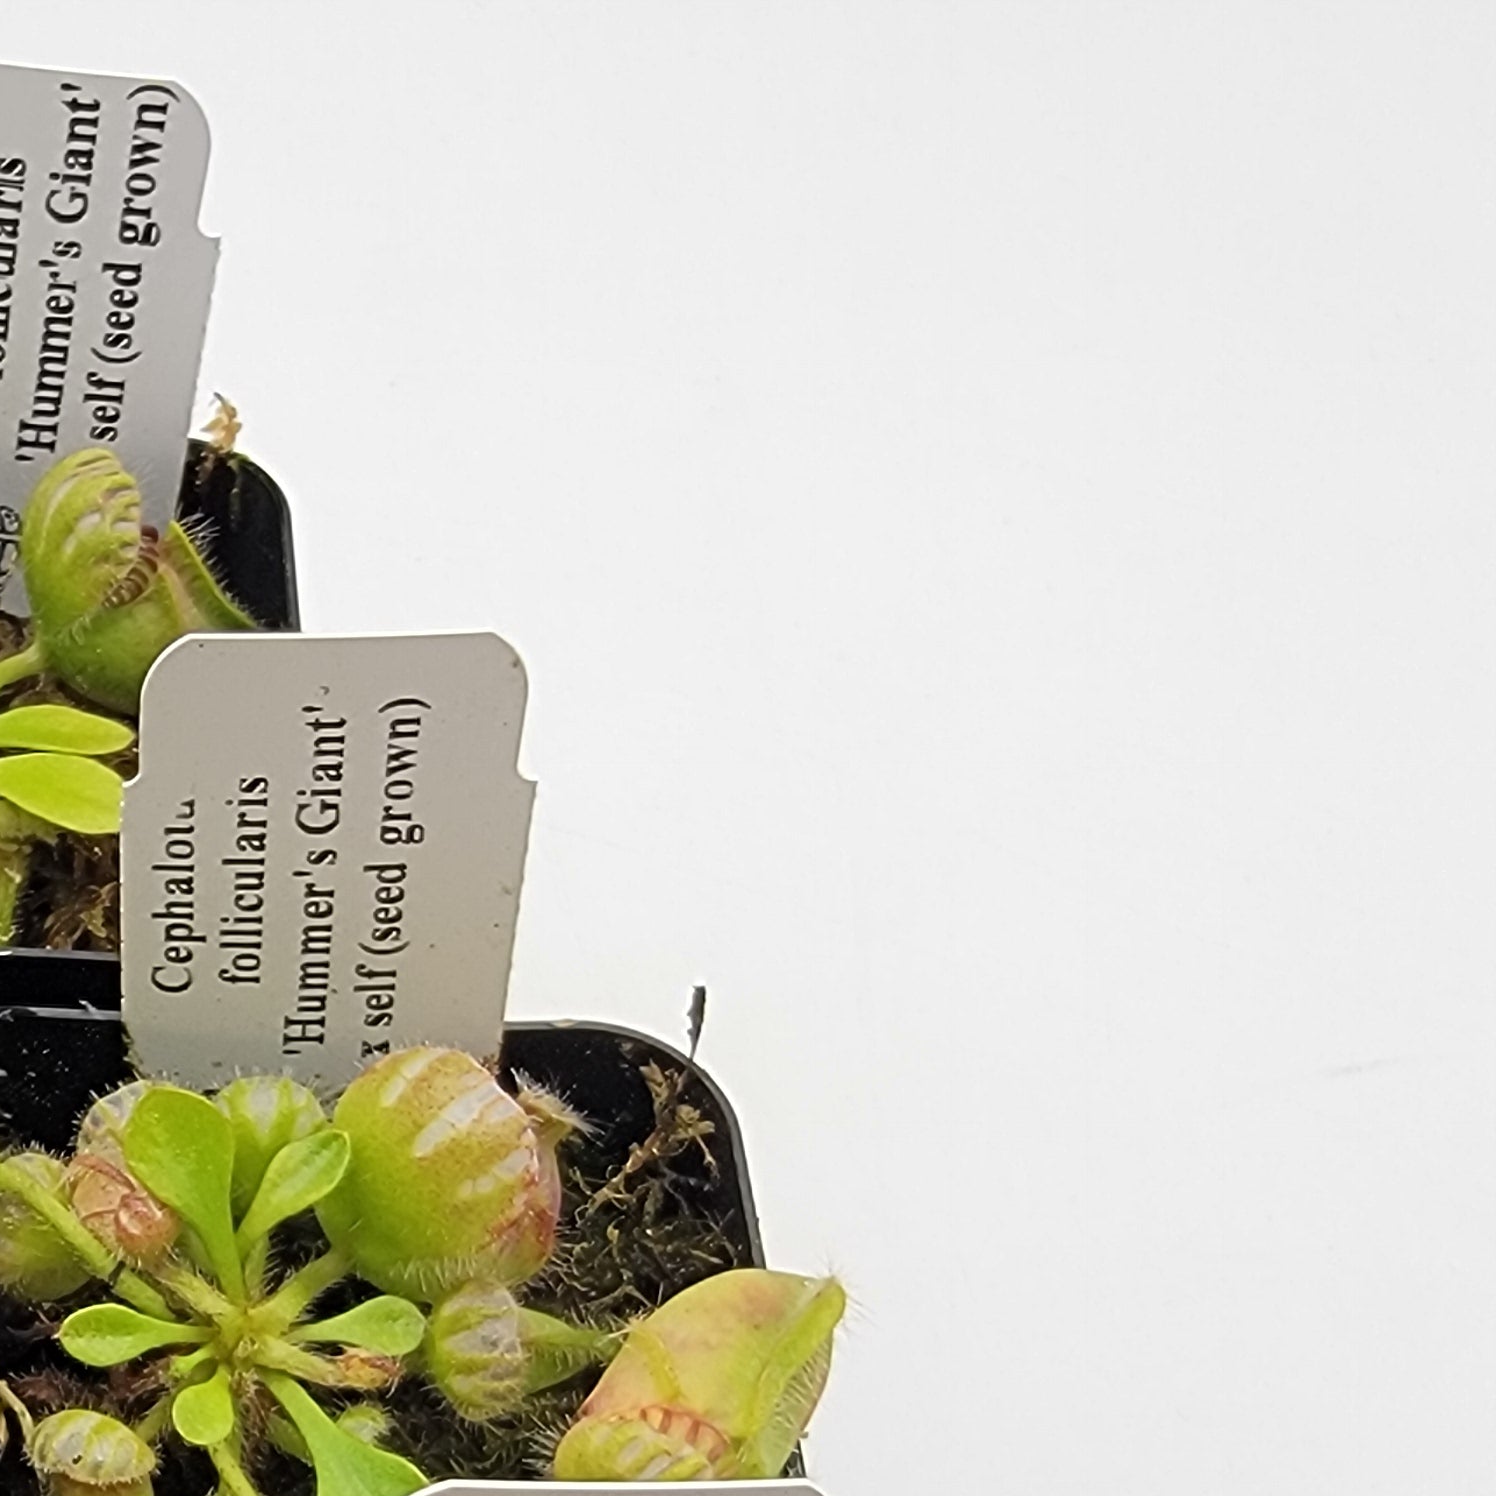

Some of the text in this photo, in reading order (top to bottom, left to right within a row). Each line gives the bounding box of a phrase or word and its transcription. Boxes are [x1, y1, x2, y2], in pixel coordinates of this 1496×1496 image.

[14, 82, 102, 462] 'Hummer's Giant'
[82, 83, 181, 443] self (seed grown)
[378, 697, 432, 844] grown)
[218, 777, 269, 985] follicularis
[283, 704, 348, 1056] 'Hummer's Giant'
[358, 862, 410, 956] (seed
[354, 964, 397, 1027] self
